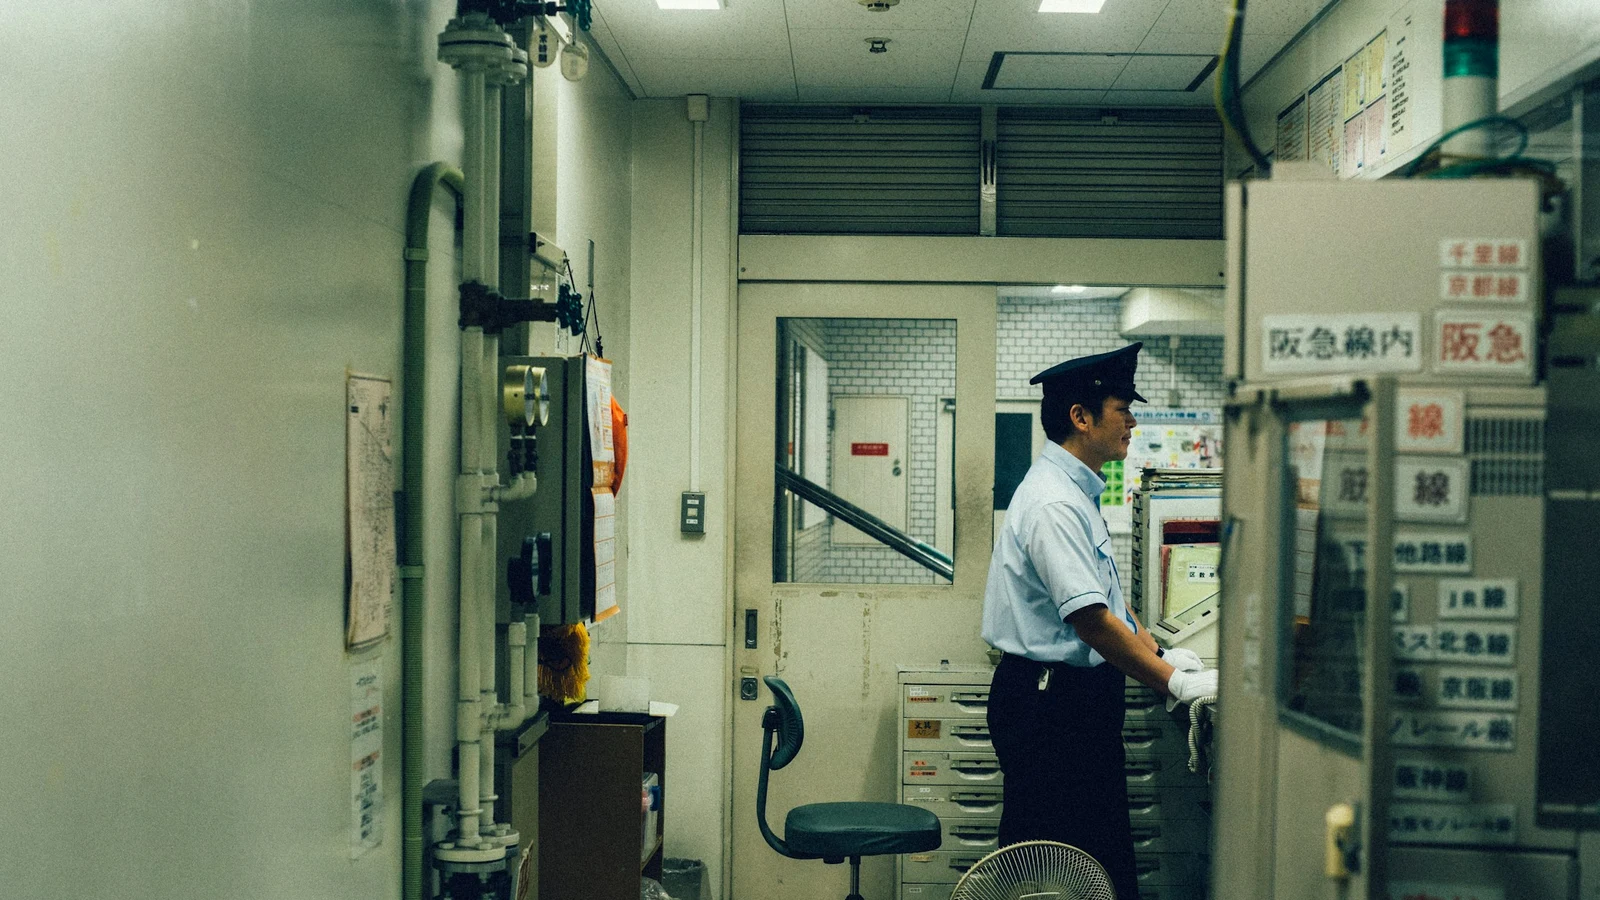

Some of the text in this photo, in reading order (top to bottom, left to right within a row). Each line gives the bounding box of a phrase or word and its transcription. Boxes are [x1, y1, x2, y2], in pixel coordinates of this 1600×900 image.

[1450, 243, 1521, 264] 千里線
[1448, 274, 1521, 298] 京都線
[1268, 326, 1414, 360] 阪急線内
[1440, 322, 1526, 364] 阪急
